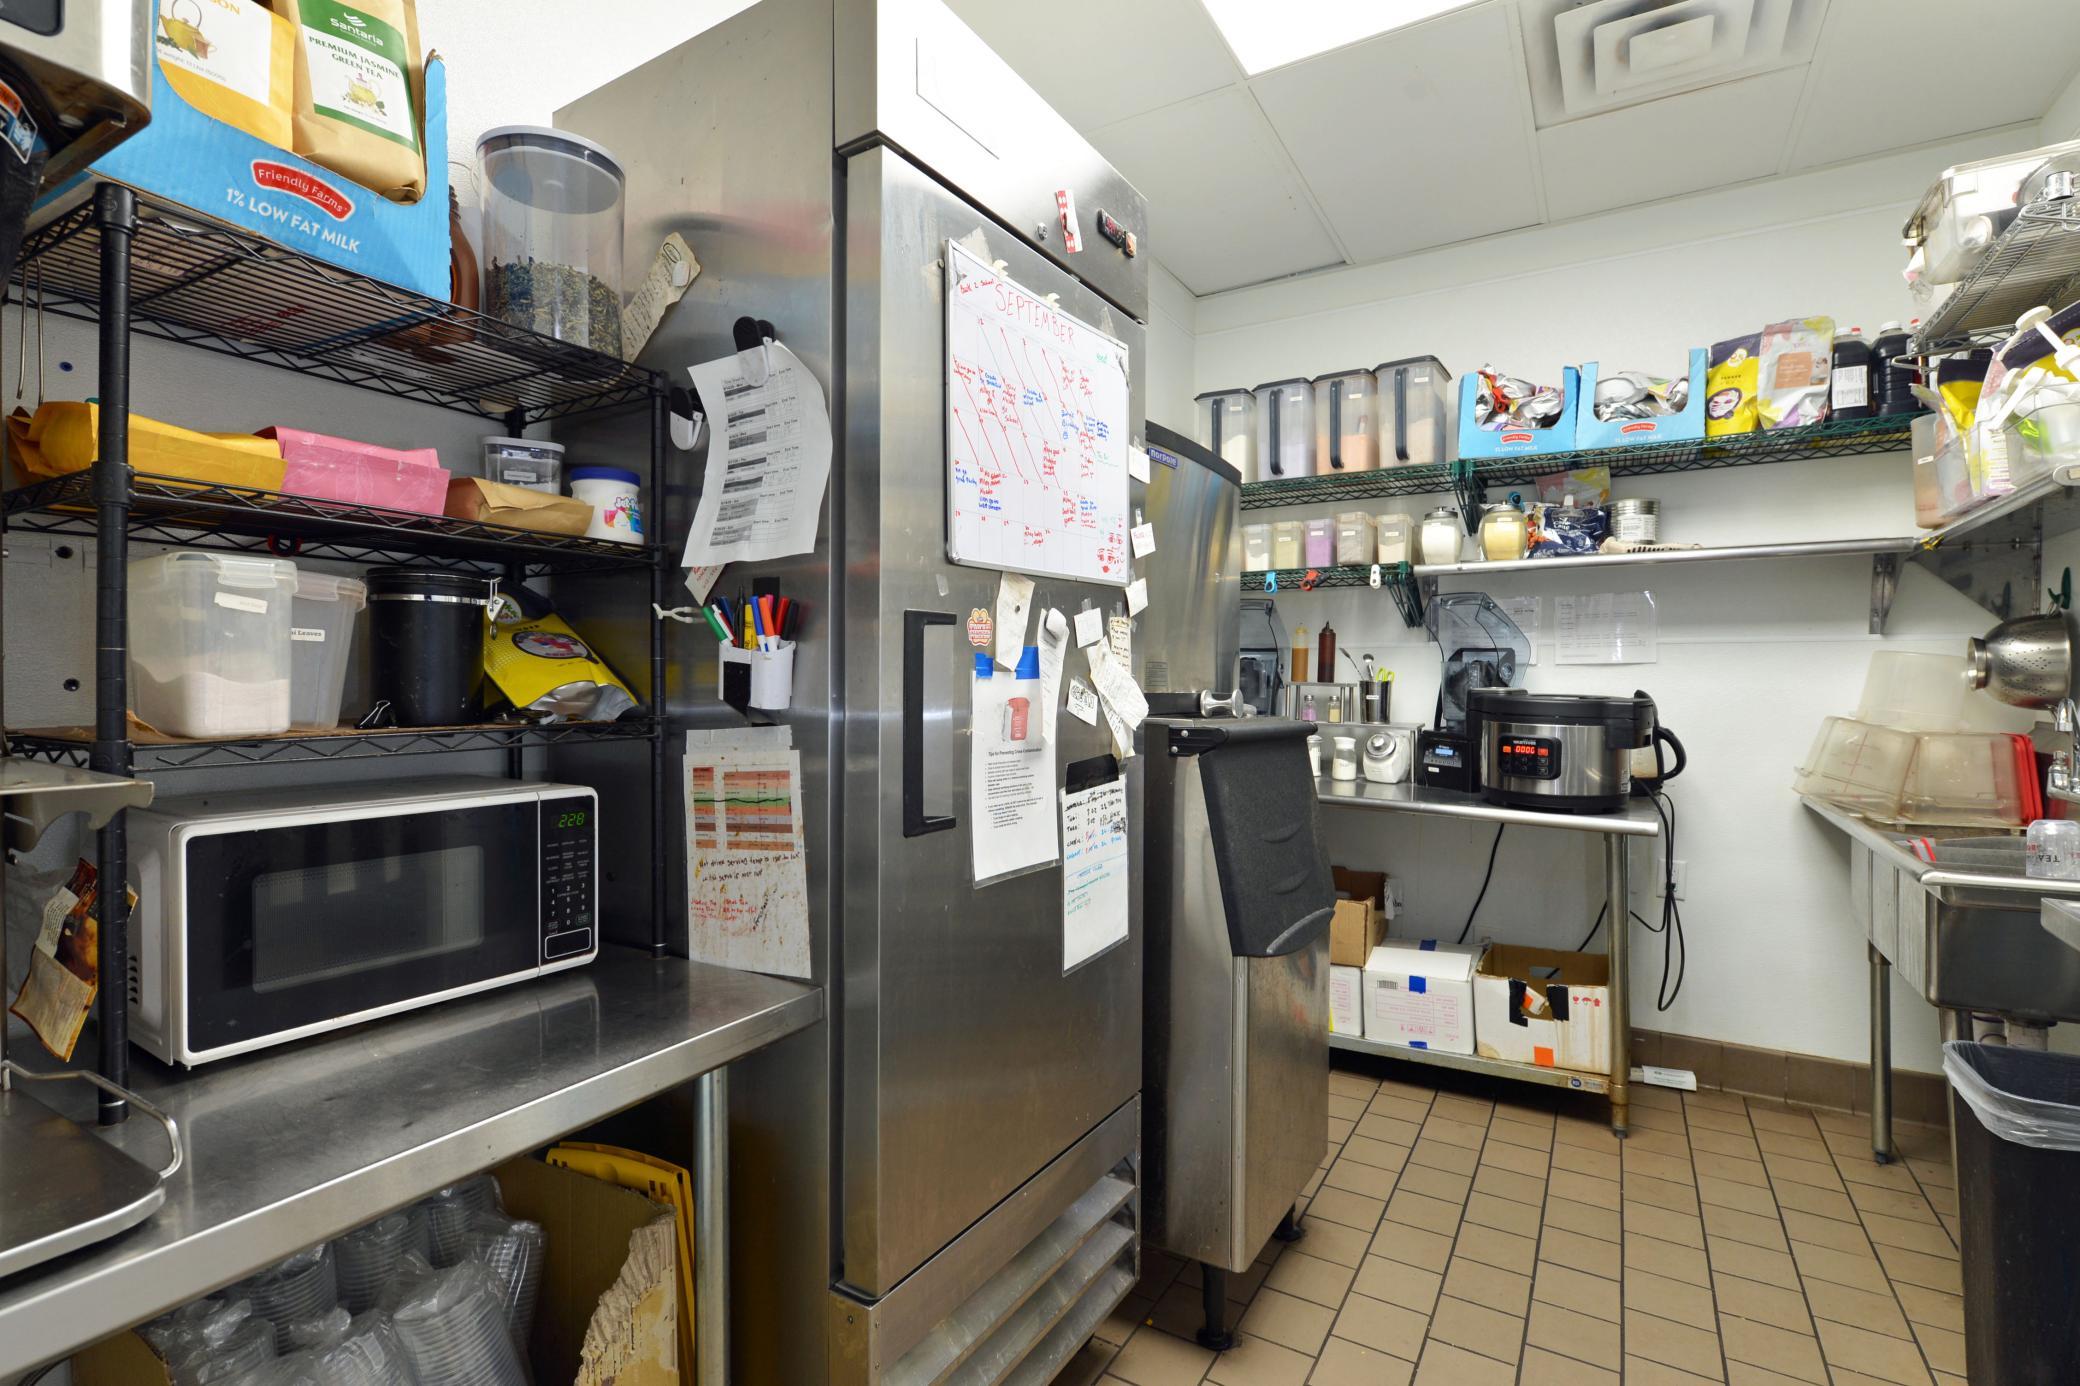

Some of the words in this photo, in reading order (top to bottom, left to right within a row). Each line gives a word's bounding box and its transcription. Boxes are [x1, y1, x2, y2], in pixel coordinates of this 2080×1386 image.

[329, 17, 384, 47] Santaria
[308, 35, 358, 60] PREMIUM
[360, 55, 400, 78] JASMINE
[331, 53, 363, 71] GREEN
[366, 66, 384, 81] TEA
[258, 168, 310, 193] Friendly
[311, 184, 343, 213] Farms
[226, 187, 245, 207] 1%
[248, 197, 289, 224] LOW
[290, 214, 321, 237] FAT
[321, 228, 361, 254] MILK
[994, 282, 1075, 345] SEPTEMBER
